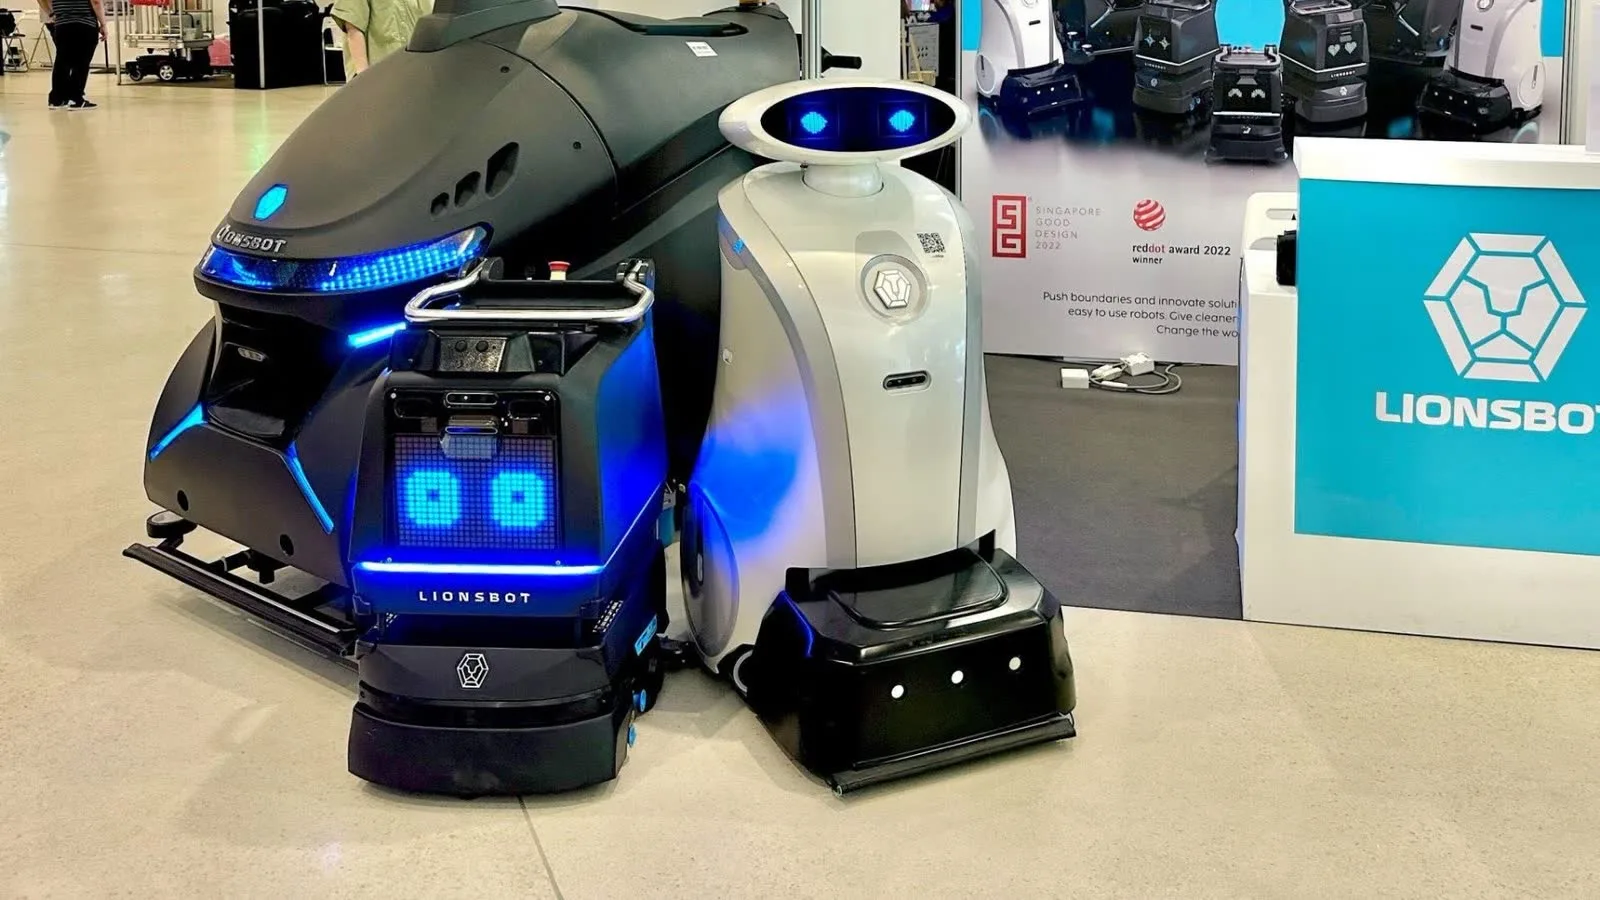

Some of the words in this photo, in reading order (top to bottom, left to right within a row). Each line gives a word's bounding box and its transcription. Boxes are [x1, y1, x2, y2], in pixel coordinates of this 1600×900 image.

[1035, 206, 1102, 216] SINGAPORE
[1035, 218, 1070, 227] GOOD
[216, 223, 287, 252] LIONSBOT
[1035, 229, 1078, 239] DESIGN
[1035, 241, 1061, 250] 2022
[1132, 243, 1165, 253] reddot
[1168, 245, 1200, 255] award
[1203, 245, 1231, 256] 2022
[1132, 256, 1163, 264] winner
[1043, 291, 1068, 301] Push
[1071, 292, 1132, 304] boundaries
[1134, 296, 1155, 305] and
[1158, 297, 1206, 307] innovate
[1068, 308, 1093, 318] easy
[1095, 308, 1106, 317] to
[1108, 310, 1127, 318] use
[1169, 311, 1193, 321] Give
[1156, 325, 1199, 337] Change
[1202, 327, 1219, 337] the
[1375, 391, 1600, 434] LIONSBO
[419, 591, 531, 604] LIONSBOT
